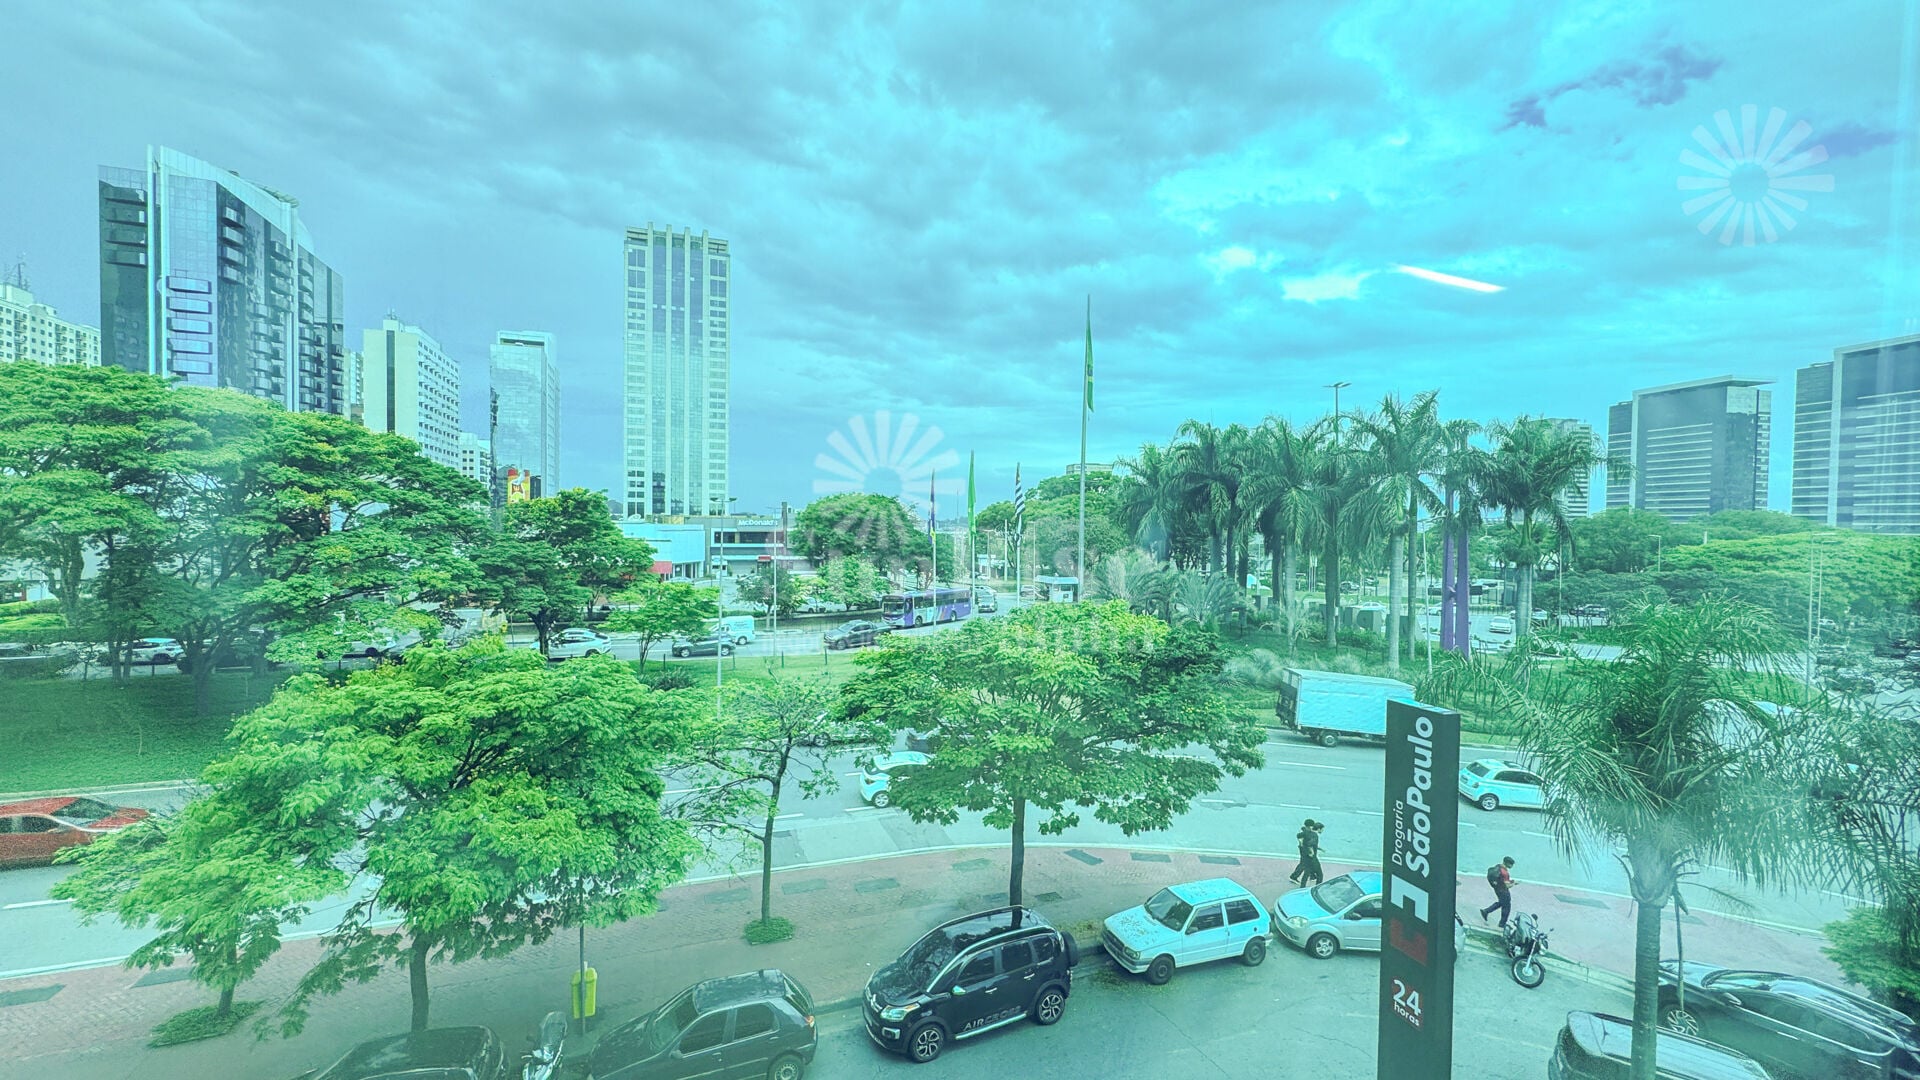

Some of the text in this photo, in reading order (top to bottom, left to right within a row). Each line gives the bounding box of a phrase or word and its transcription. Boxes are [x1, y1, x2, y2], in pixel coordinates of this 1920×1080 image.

[1392, 800, 1405, 866] Drogaria
[1393, 979, 1421, 1016] 24
[1394, 1001, 1420, 1026] horas
